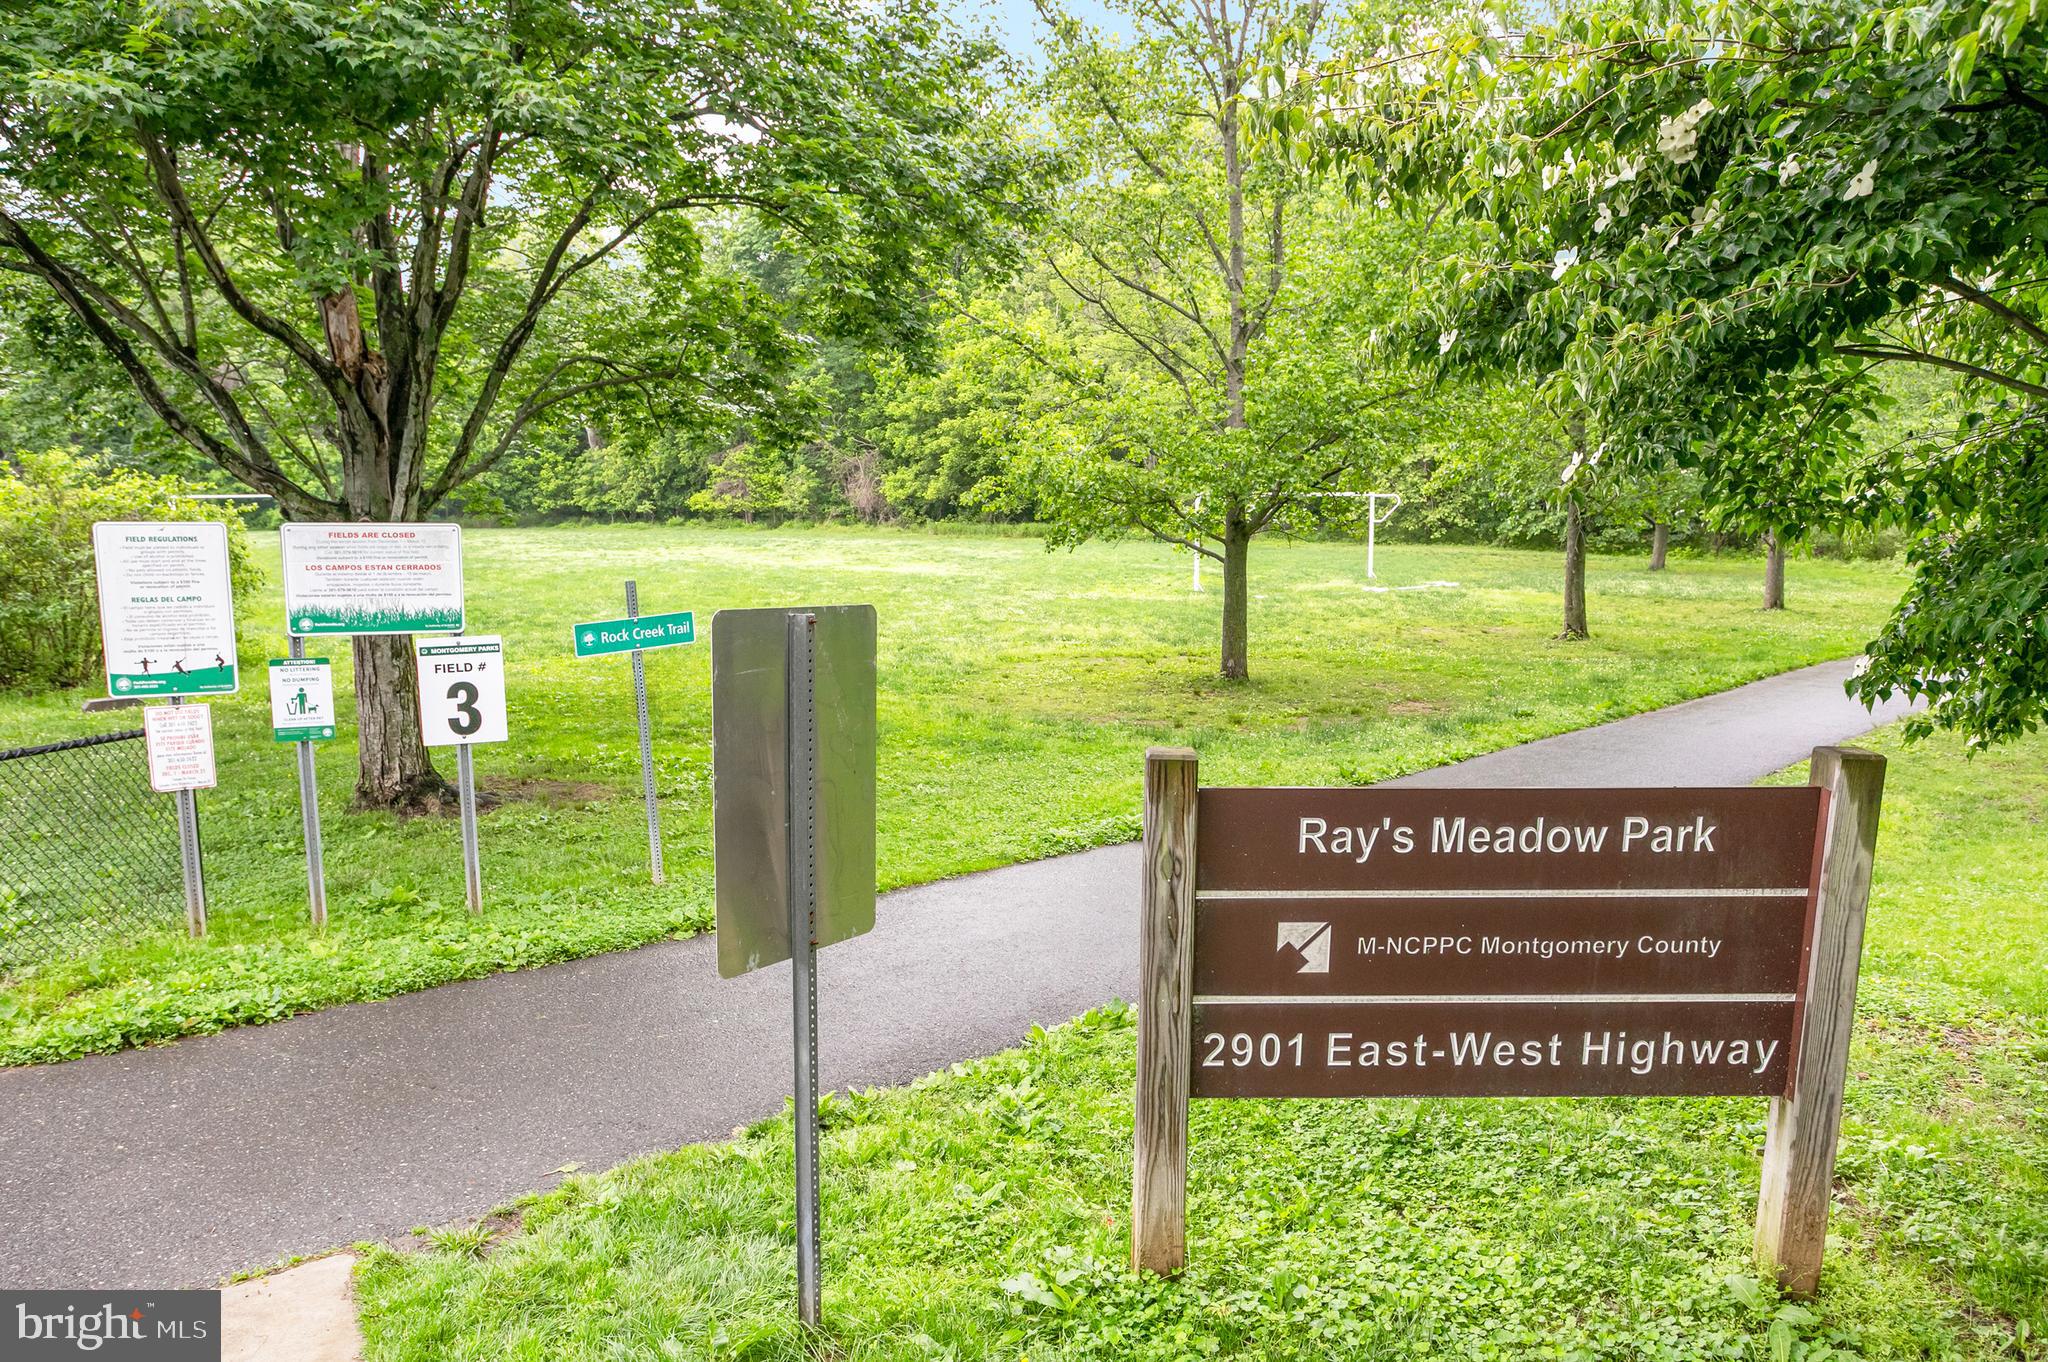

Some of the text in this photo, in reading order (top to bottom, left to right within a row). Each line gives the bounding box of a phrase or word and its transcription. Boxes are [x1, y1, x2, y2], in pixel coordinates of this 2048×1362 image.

[601, 620, 690, 644] Rock Creek Trail
[430, 646, 477, 654] MONTGOMERY
[434, 662, 487, 673] FIELD #
[446, 681, 482, 735] 3
[1299, 816, 1716, 863] Ray's Meadow Park
[1358, 936, 1721, 958] M-NCPPC Montgomery County
[1203, 1032, 1778, 1074] 2901 East-West Highway
